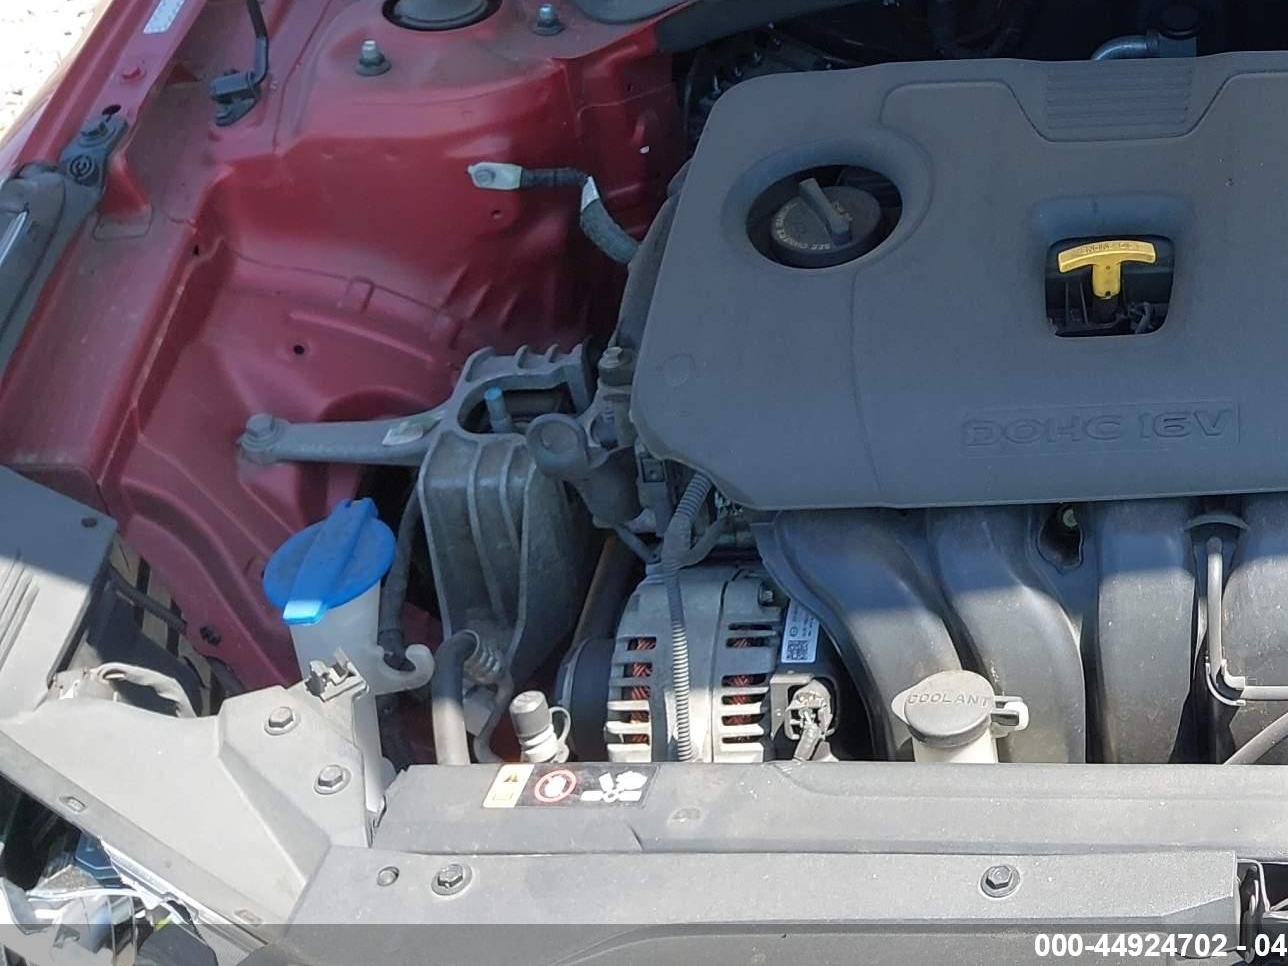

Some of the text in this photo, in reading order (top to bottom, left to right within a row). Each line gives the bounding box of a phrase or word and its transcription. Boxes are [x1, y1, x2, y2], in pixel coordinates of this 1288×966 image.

[962, 409, 1231, 447] DOHC 16V
[907, 692, 992, 708] COOLANT
